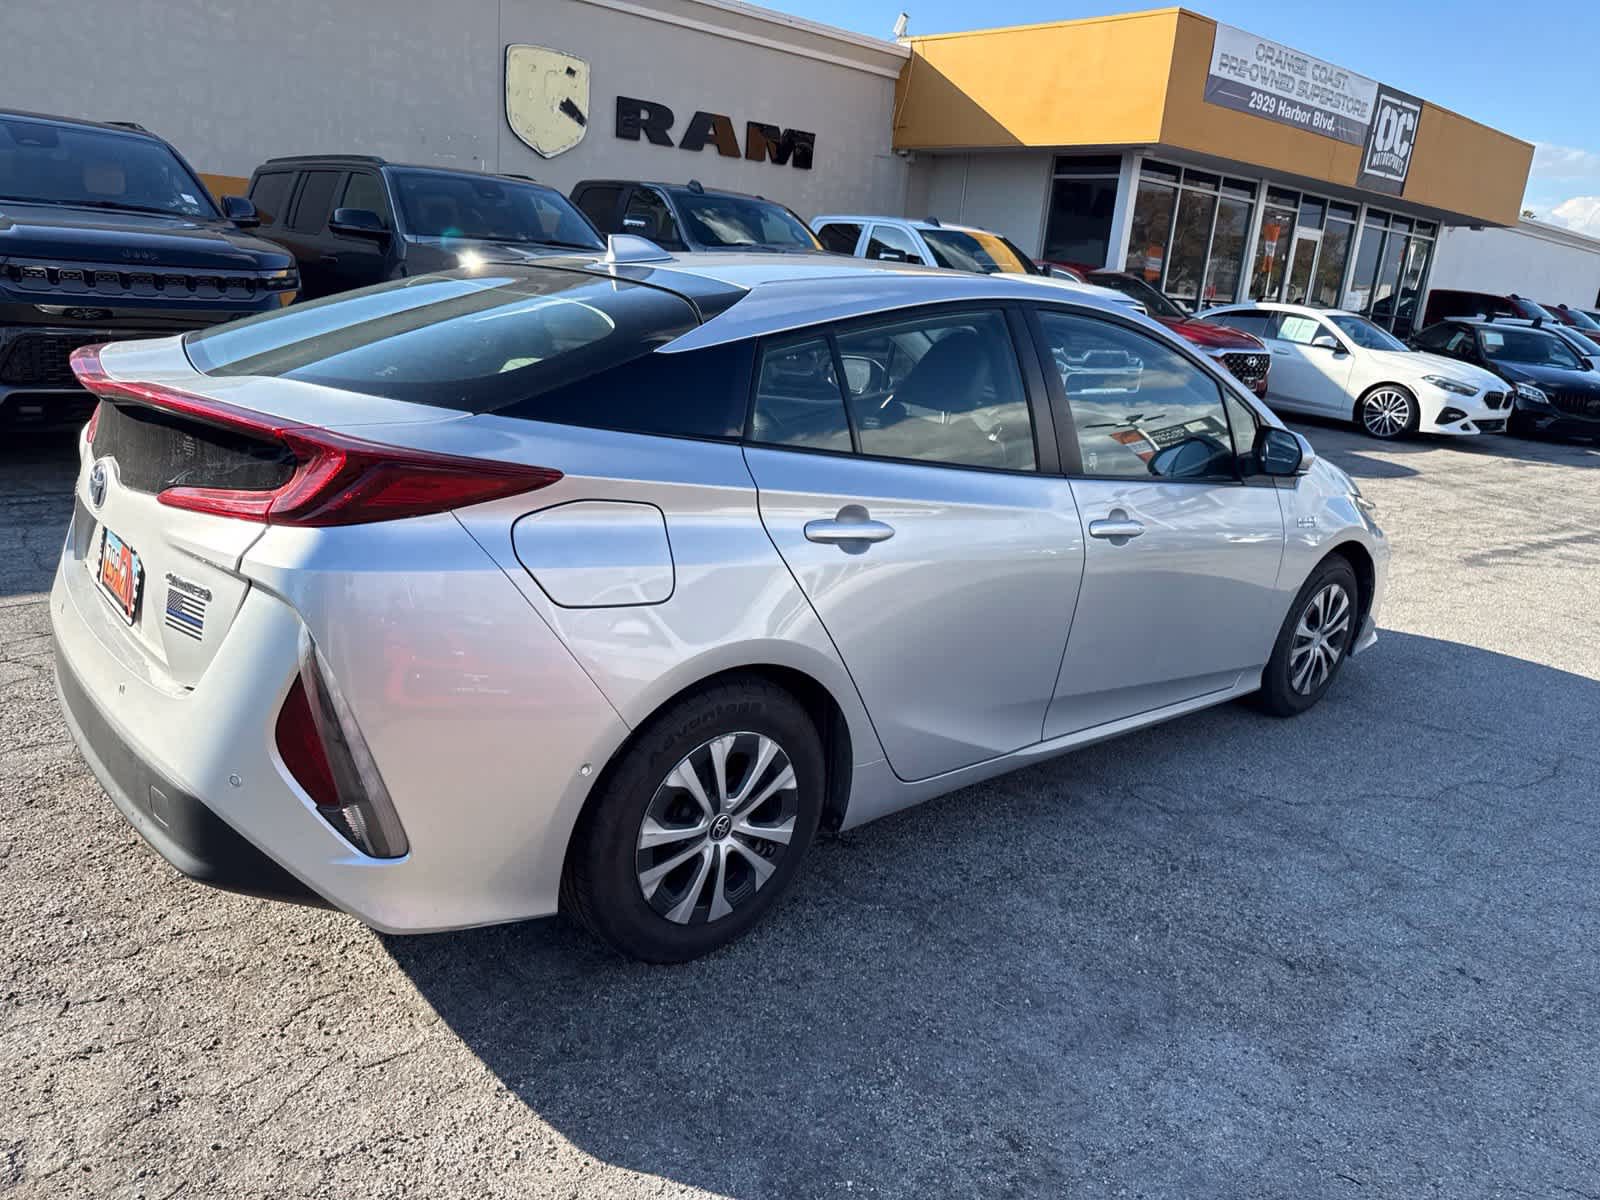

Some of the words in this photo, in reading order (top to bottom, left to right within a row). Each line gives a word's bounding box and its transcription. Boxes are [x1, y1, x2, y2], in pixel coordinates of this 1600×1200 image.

[1218, 52, 1296, 94] PRE-OWNED
[1296, 79, 1370, 118] SUPERSTORE
[1255, 43, 1309, 76] ORANGE
[1312, 63, 1349, 91] COAST
[615, 95, 817, 170] RAM
[1248, 91, 1277, 114] 2929
[1277, 100, 1311, 125] Harbor
[1312, 112, 1336, 132] Blvd.
[1375, 104, 1415, 160] OC
